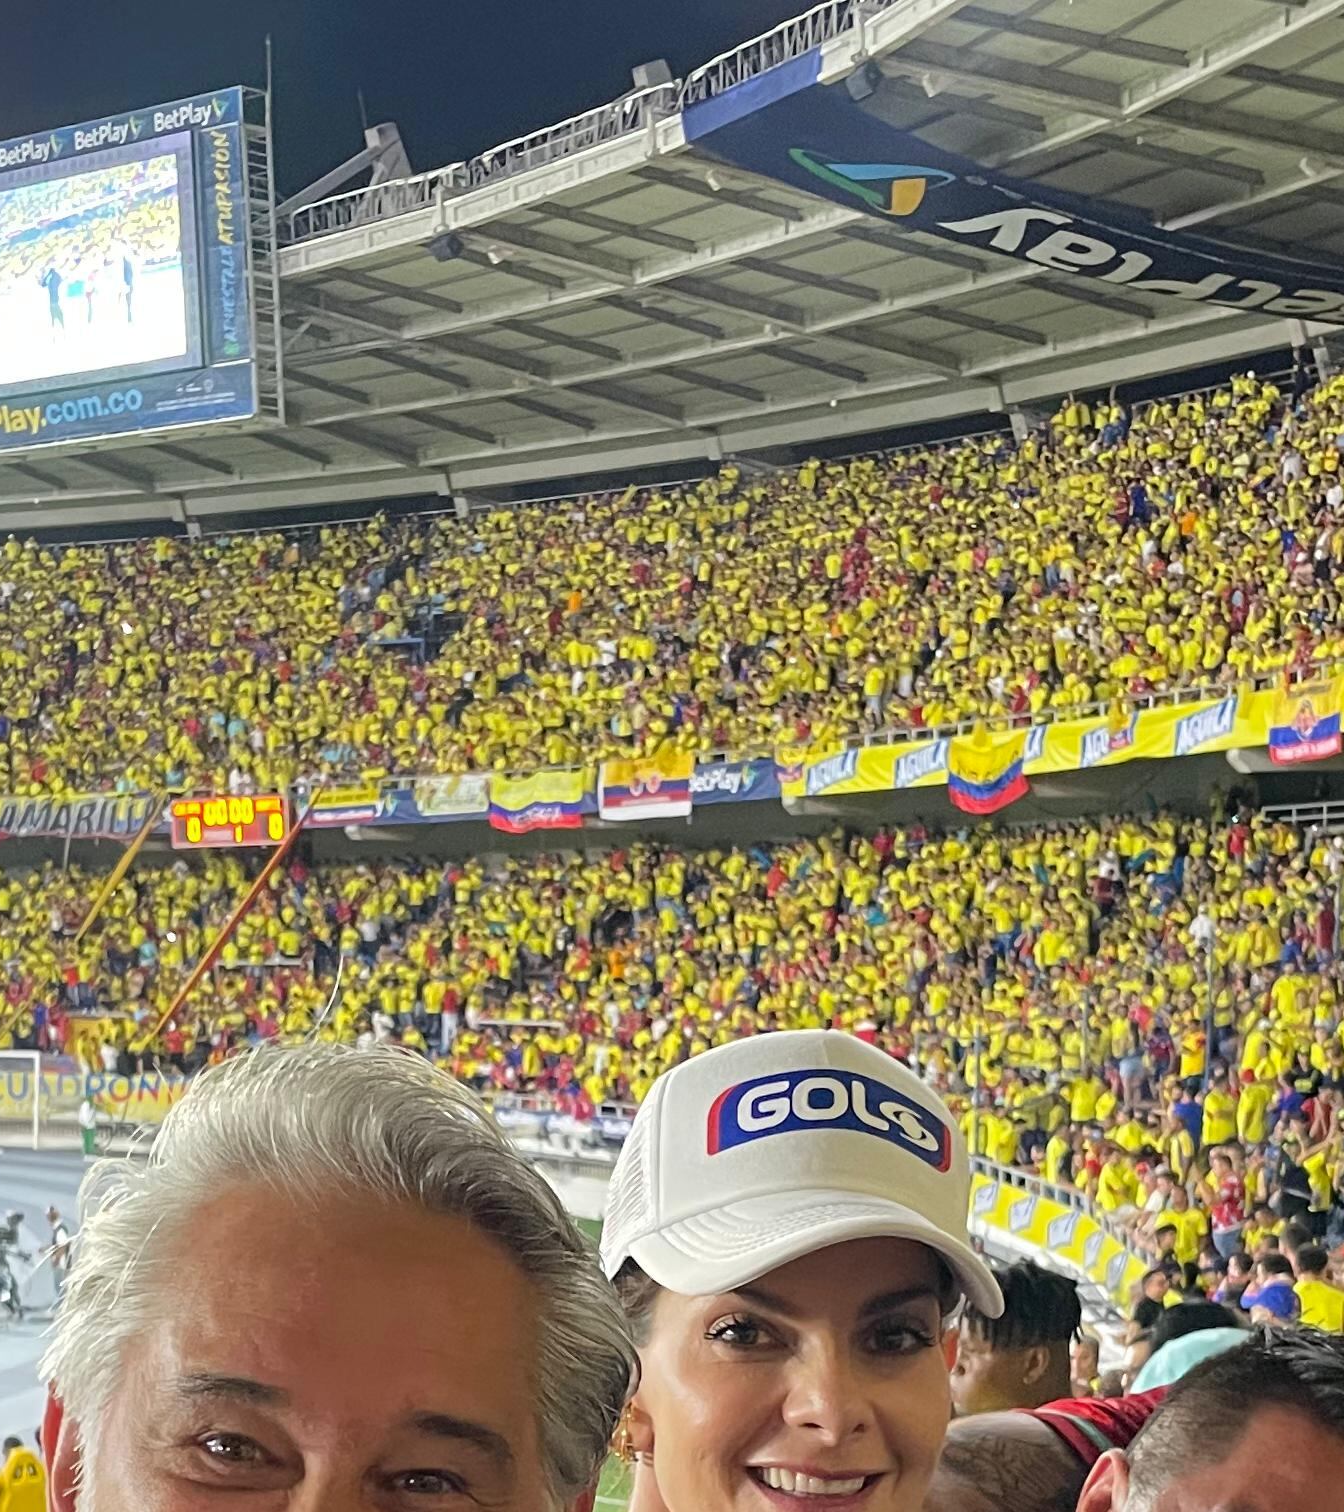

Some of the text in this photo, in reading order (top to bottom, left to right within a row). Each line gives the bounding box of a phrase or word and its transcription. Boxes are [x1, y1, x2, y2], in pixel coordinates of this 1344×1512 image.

[154, 102, 212, 132] BetPlay
[74, 121, 130, 151] BetPlay
[737, 1077, 940, 1152] GOLS
